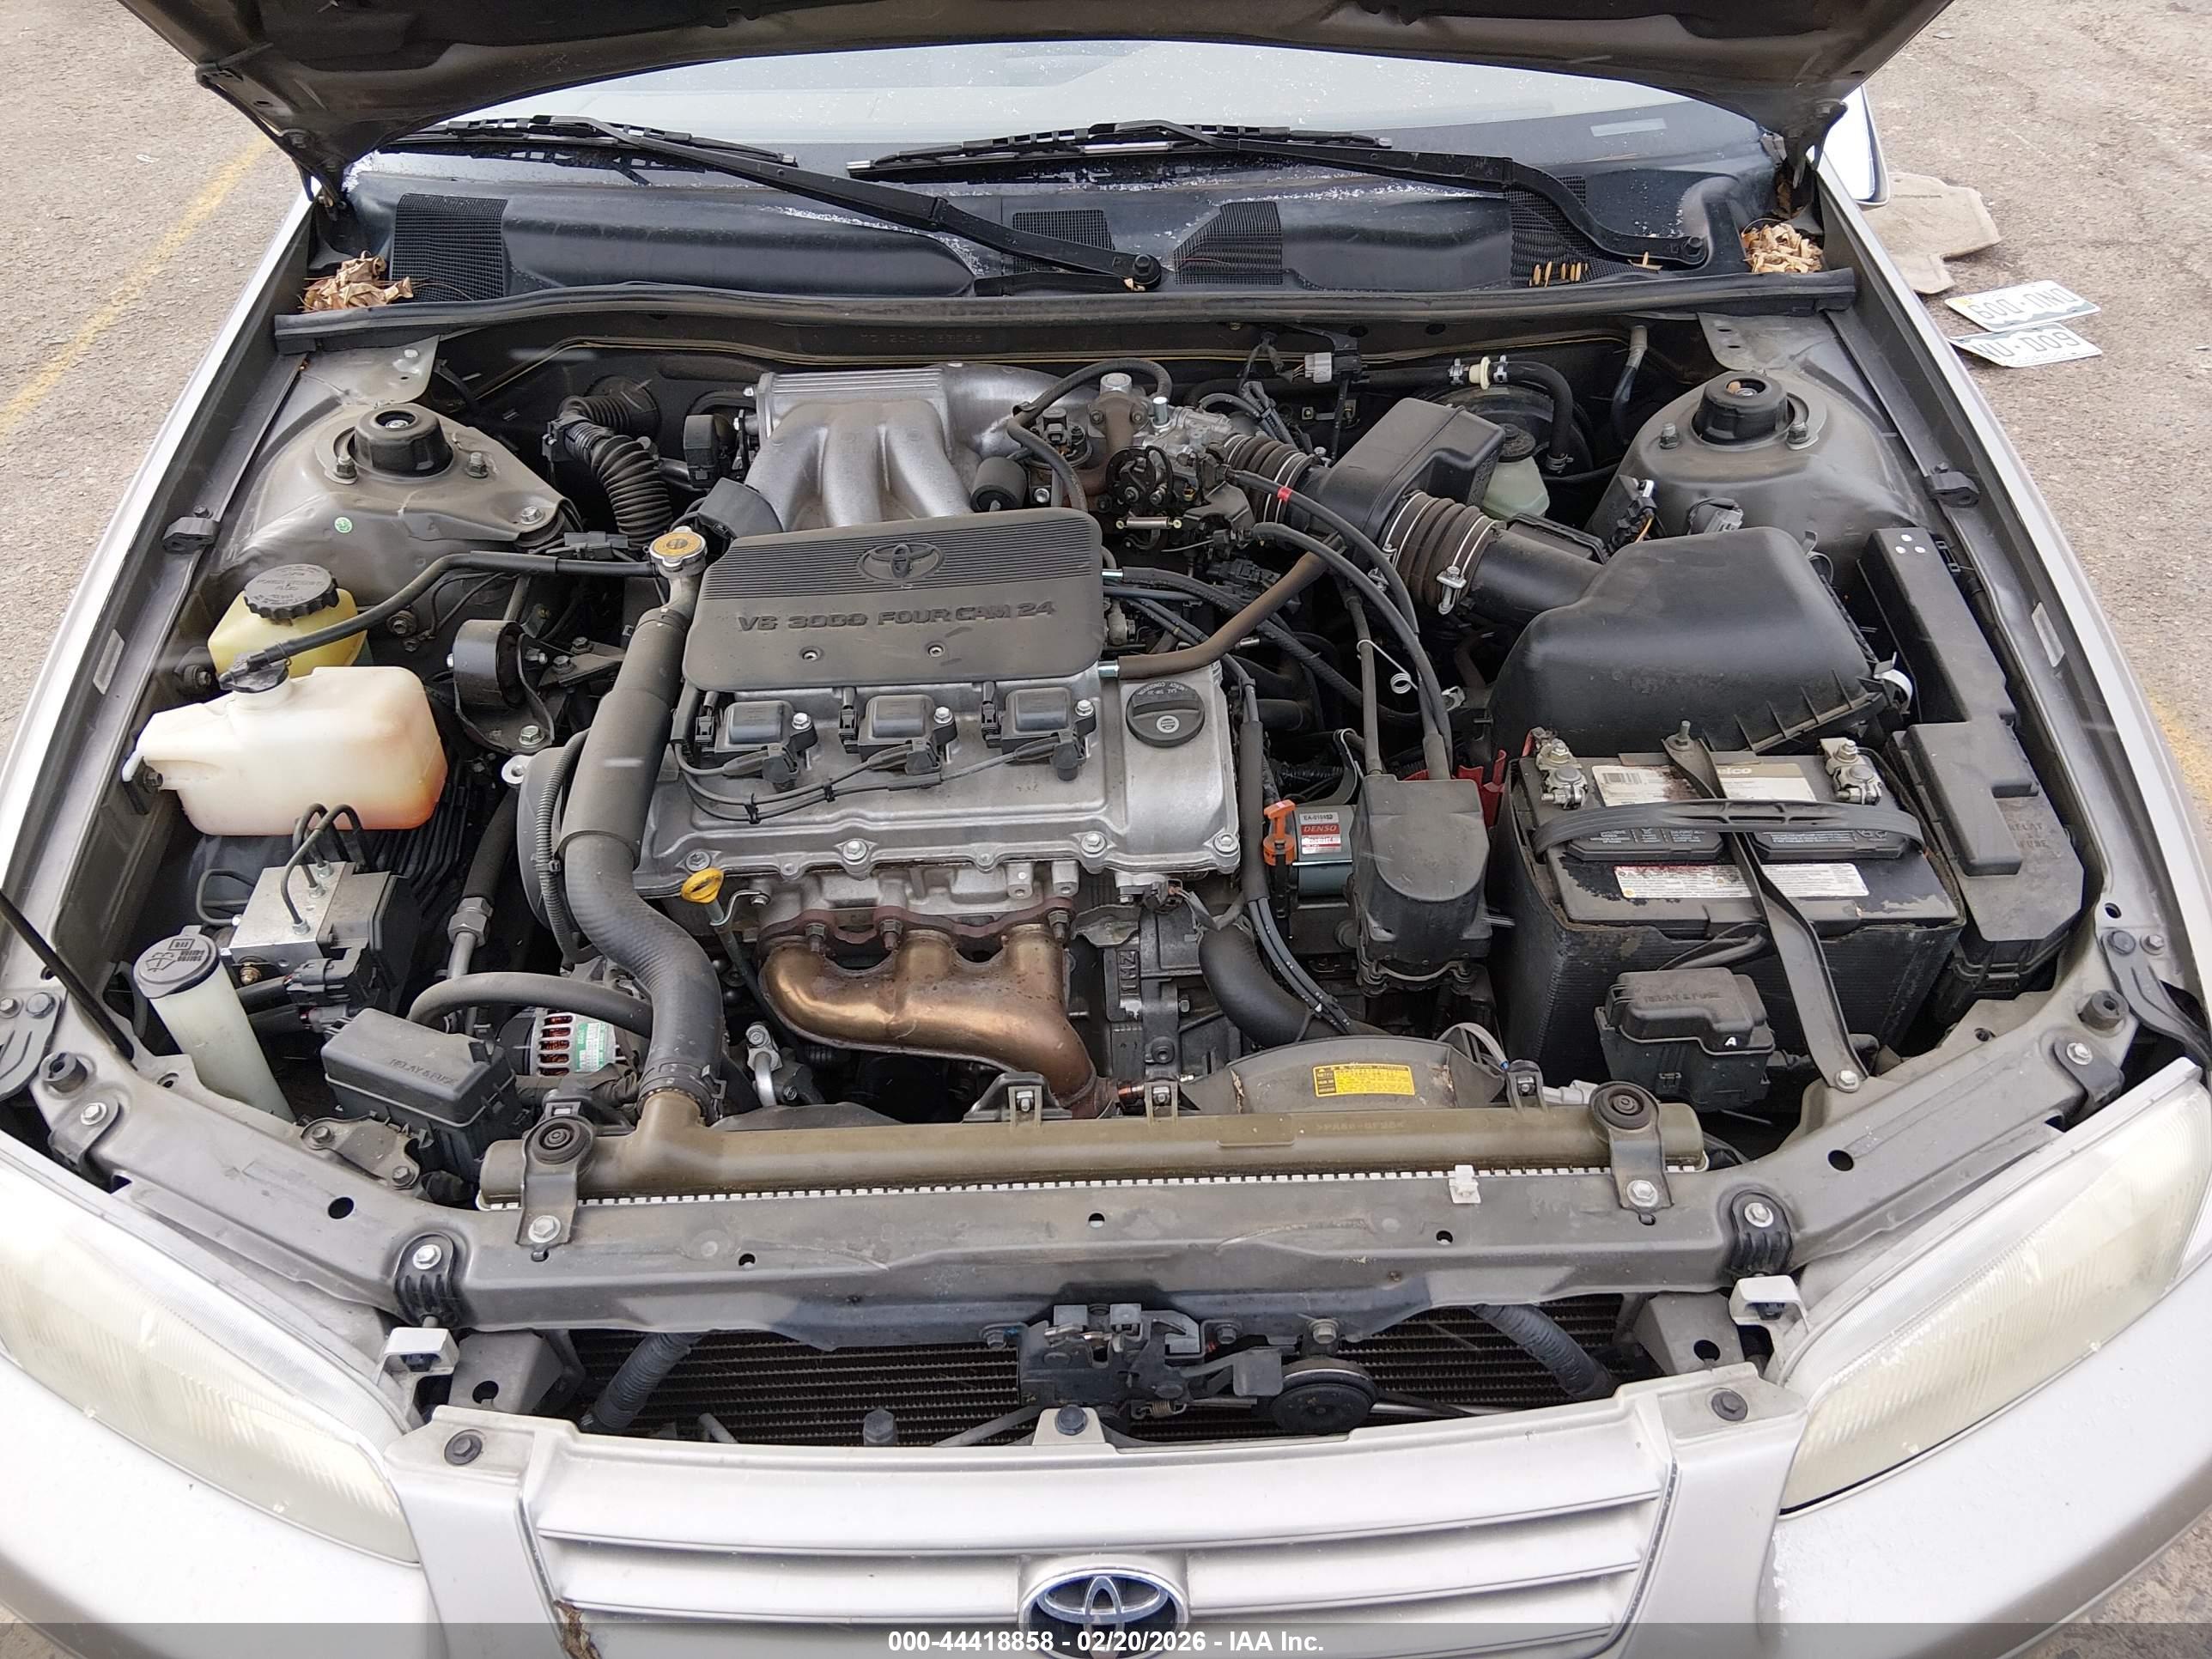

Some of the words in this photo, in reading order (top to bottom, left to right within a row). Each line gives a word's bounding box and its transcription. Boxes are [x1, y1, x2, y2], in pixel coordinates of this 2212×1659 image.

[738, 616, 778, 631] V6
[787, 611, 868, 629] 3000
[878, 607, 951, 627] FOUR
[954, 605, 1012, 622] CAM
[1017, 600, 1056, 618] 24
[1304, 824, 1337, 833] DENSO
[1724, 1036, 1737, 1047] A
